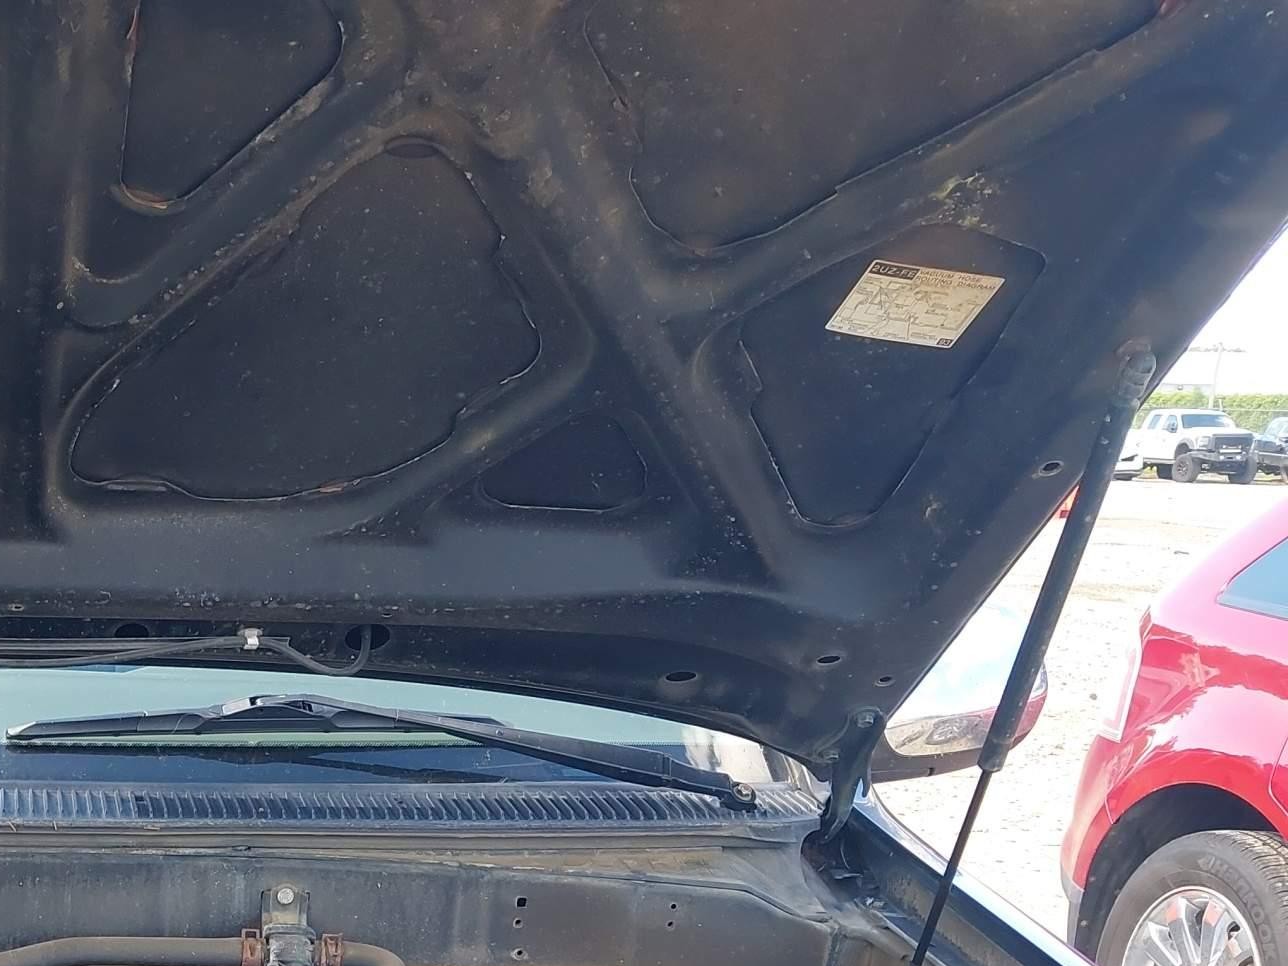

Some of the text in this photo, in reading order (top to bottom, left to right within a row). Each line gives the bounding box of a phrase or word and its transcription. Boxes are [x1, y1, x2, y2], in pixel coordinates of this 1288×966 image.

[871, 264, 917, 279] 2UZ-FE
[919, 270, 984, 283] VACUUM HOSE
[915, 275, 997, 290] ROUTING DIAGRAM
